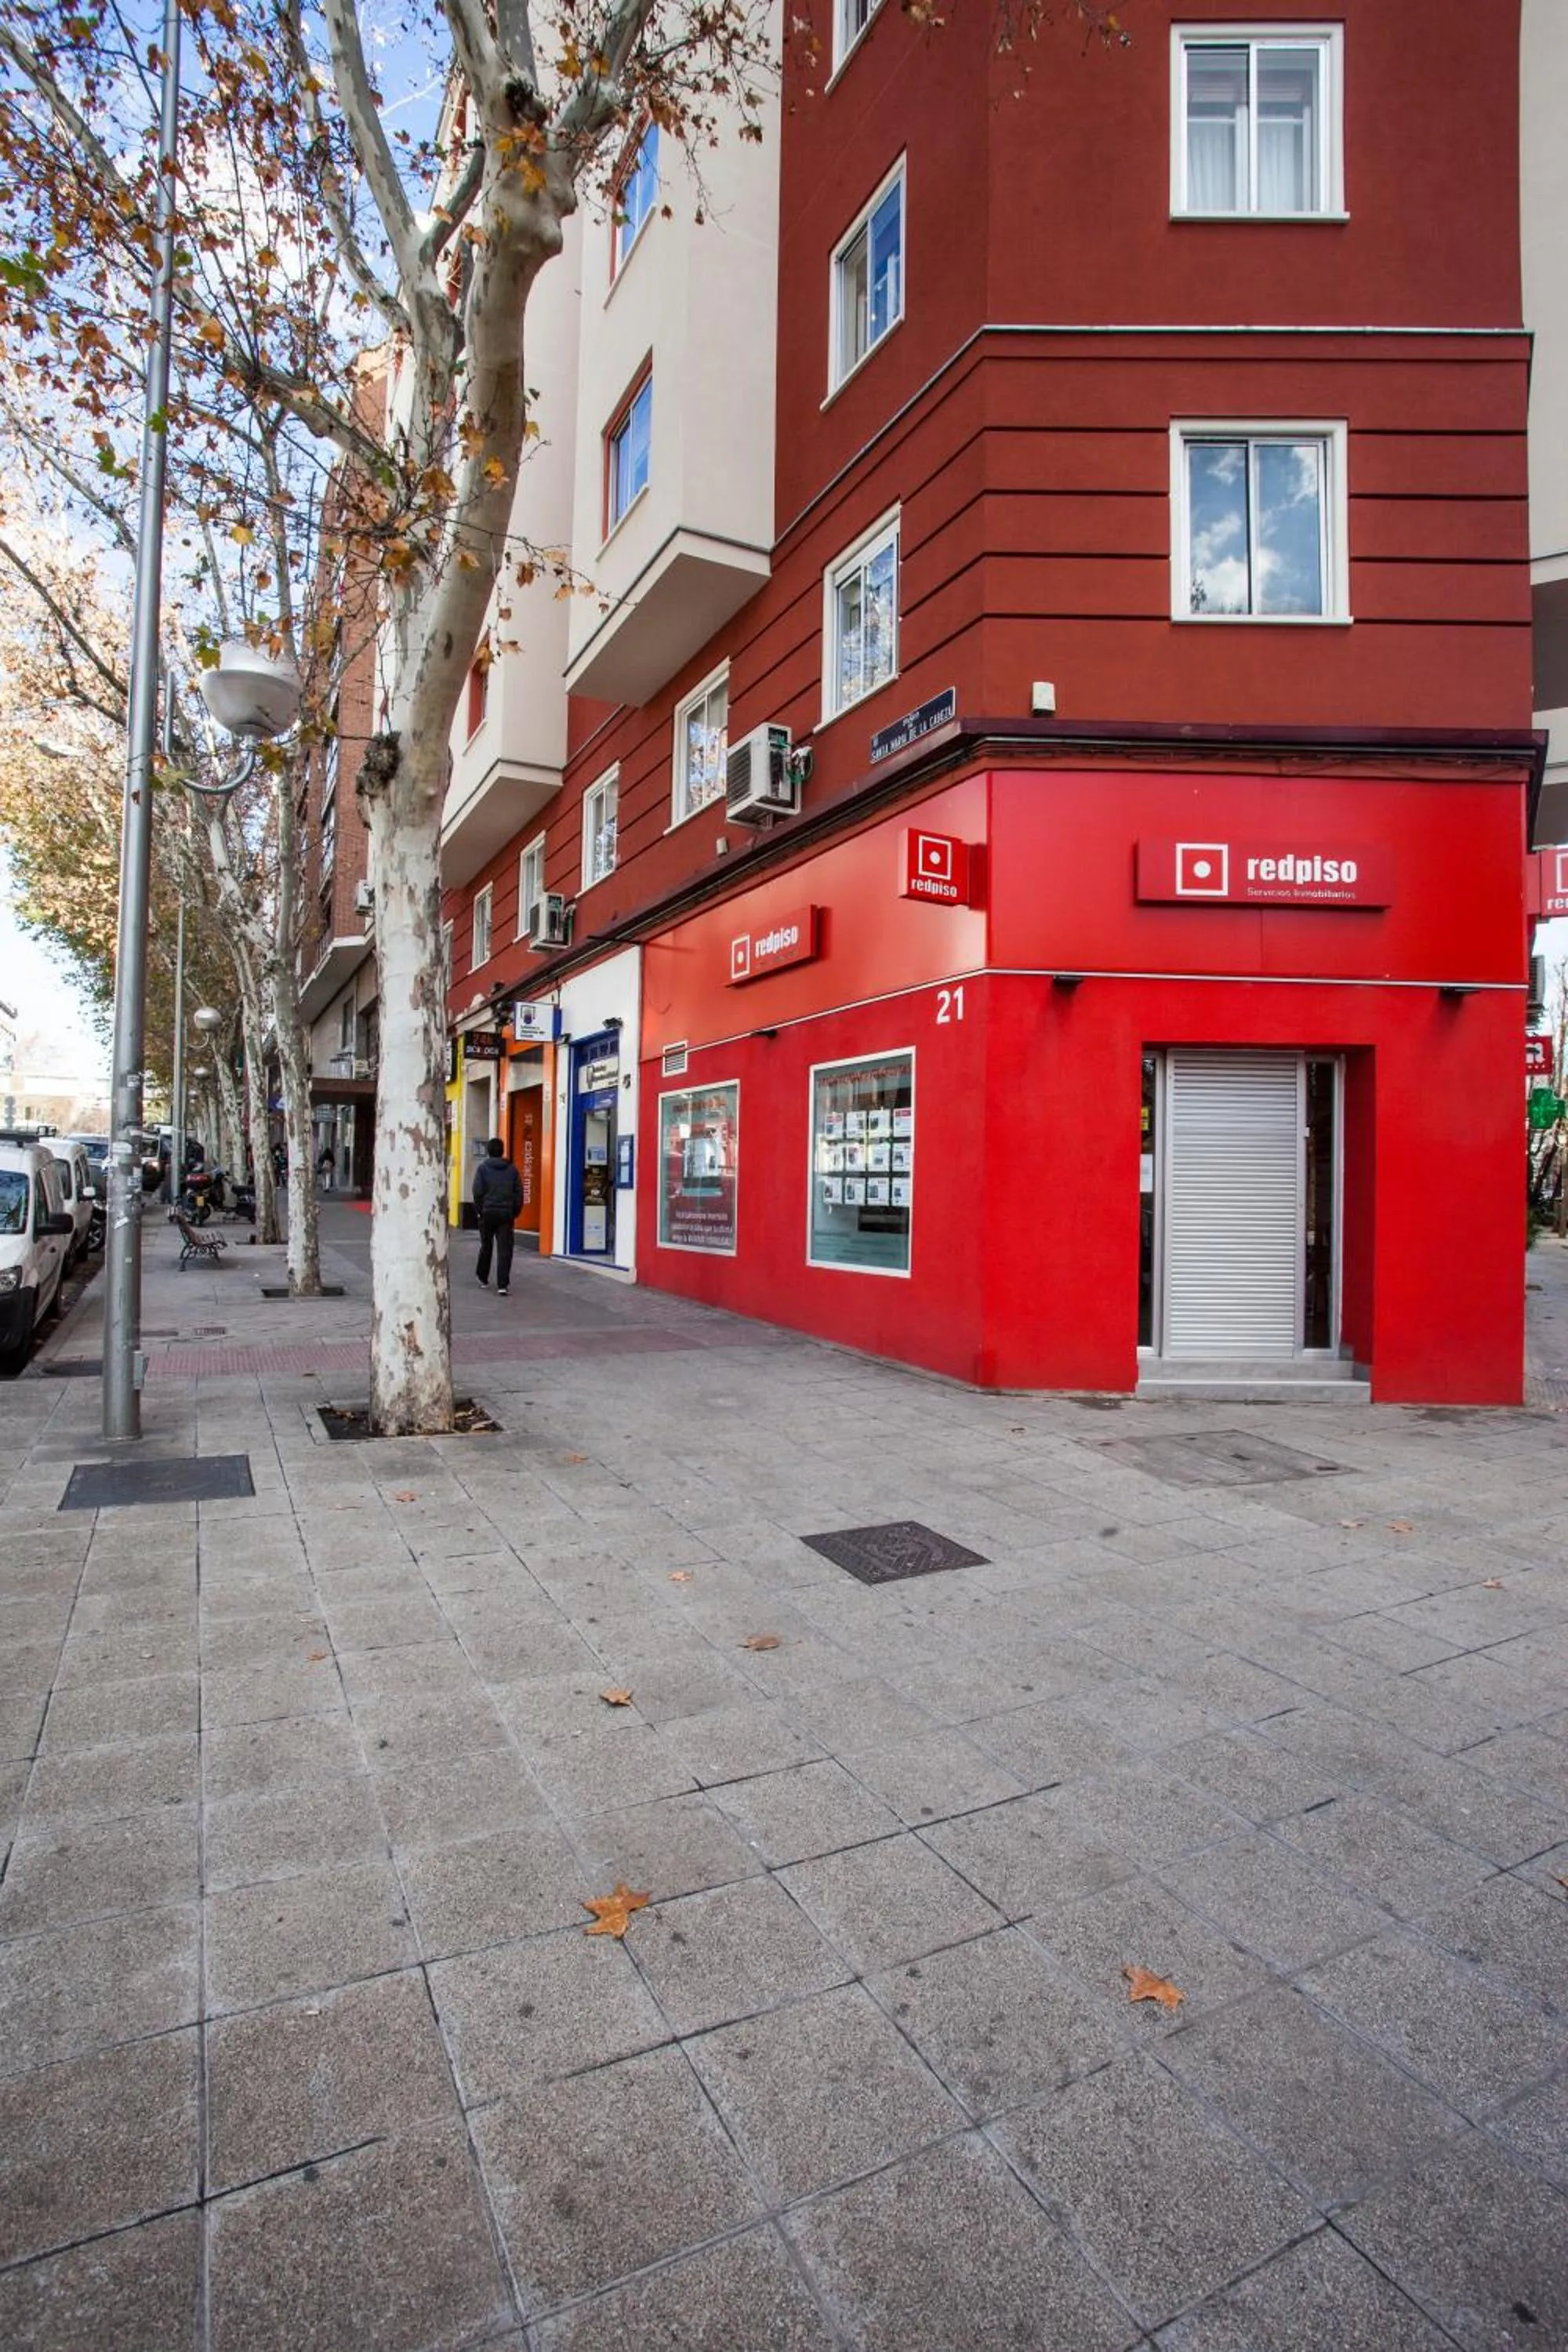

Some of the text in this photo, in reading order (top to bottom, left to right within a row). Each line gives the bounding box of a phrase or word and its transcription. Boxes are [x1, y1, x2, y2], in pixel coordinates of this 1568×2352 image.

[1247, 854, 1357, 884] redpiso
[911, 878, 958, 898] redpiso
[1547, 897, 1568, 910] re
[754, 925, 799, 958] redpiso
[935, 985, 964, 1025] 21
